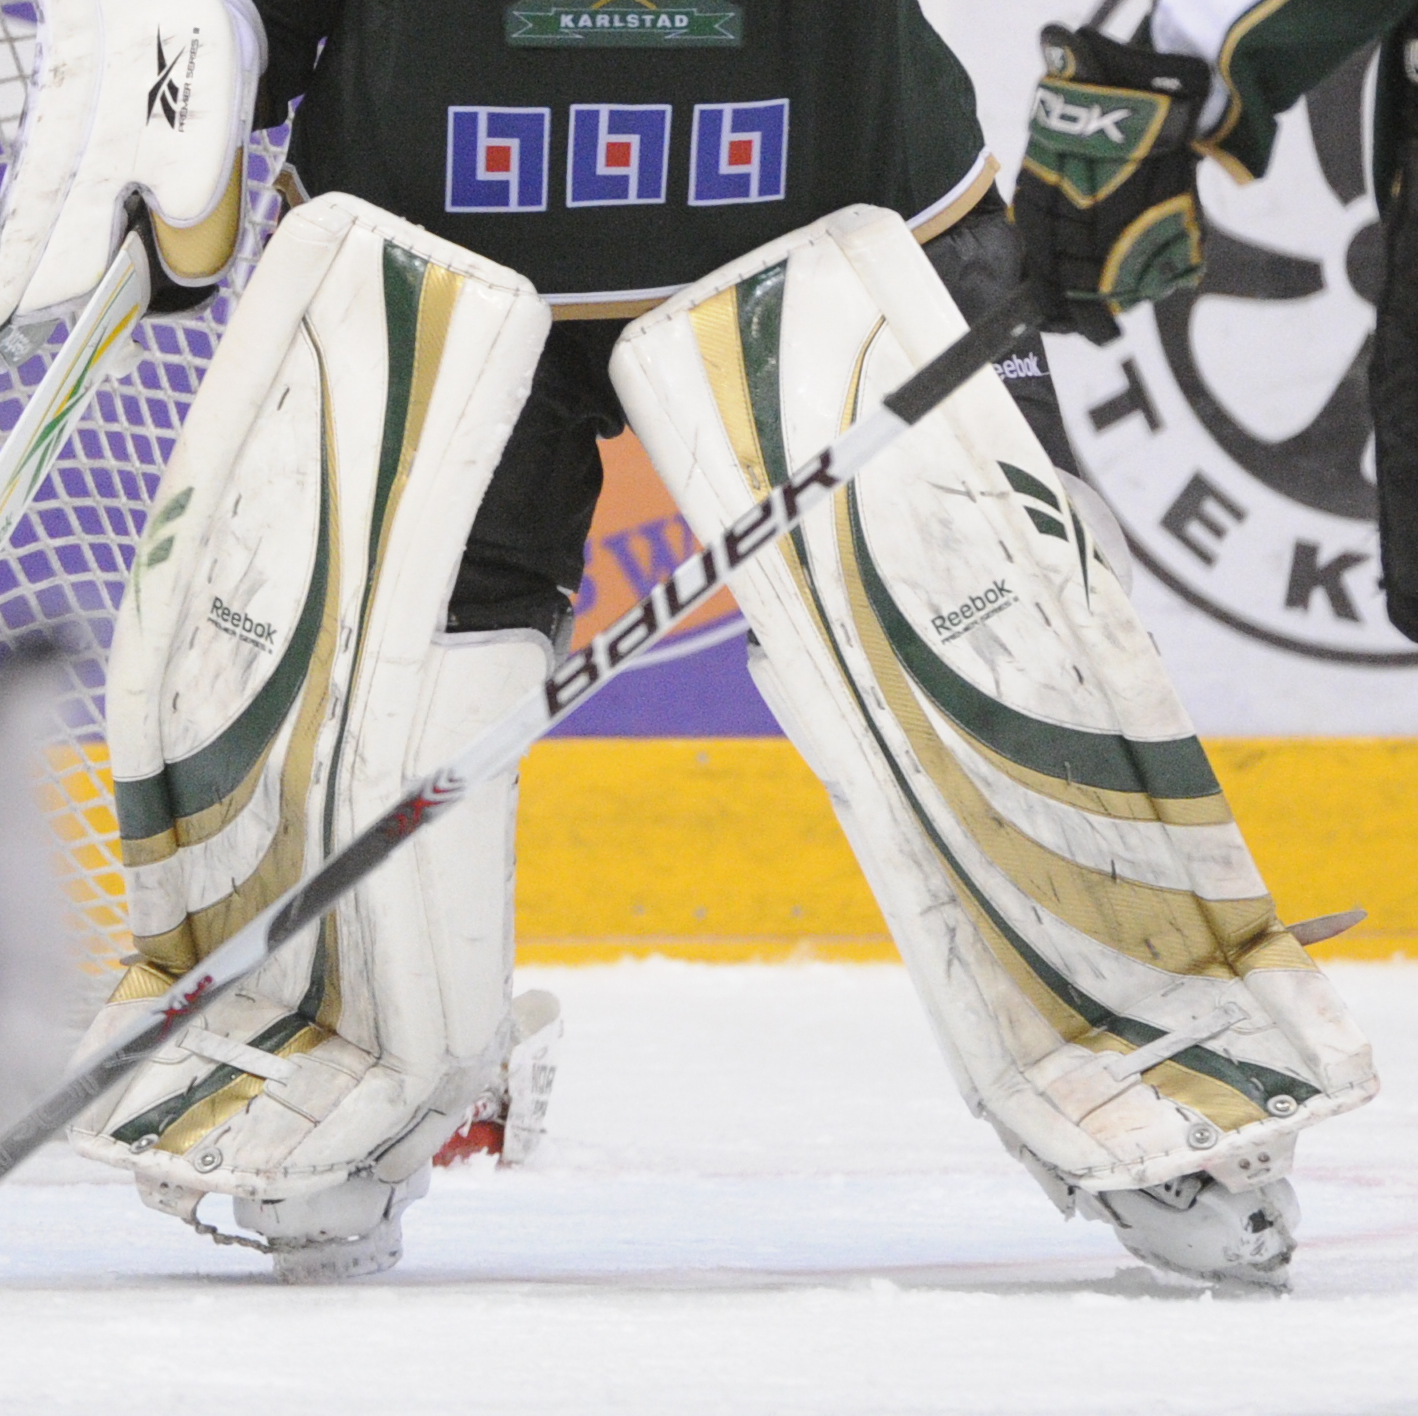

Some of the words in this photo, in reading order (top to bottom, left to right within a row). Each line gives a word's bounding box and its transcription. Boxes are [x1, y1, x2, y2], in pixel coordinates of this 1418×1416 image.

[560, 13, 690, 29] KARLSTAD
[992, 351, 1043, 381] eebok
[1087, 354, 1373, 625] TEK
[210, 595, 278, 646] Reebok
[930, 578, 1014, 636] Reebok
